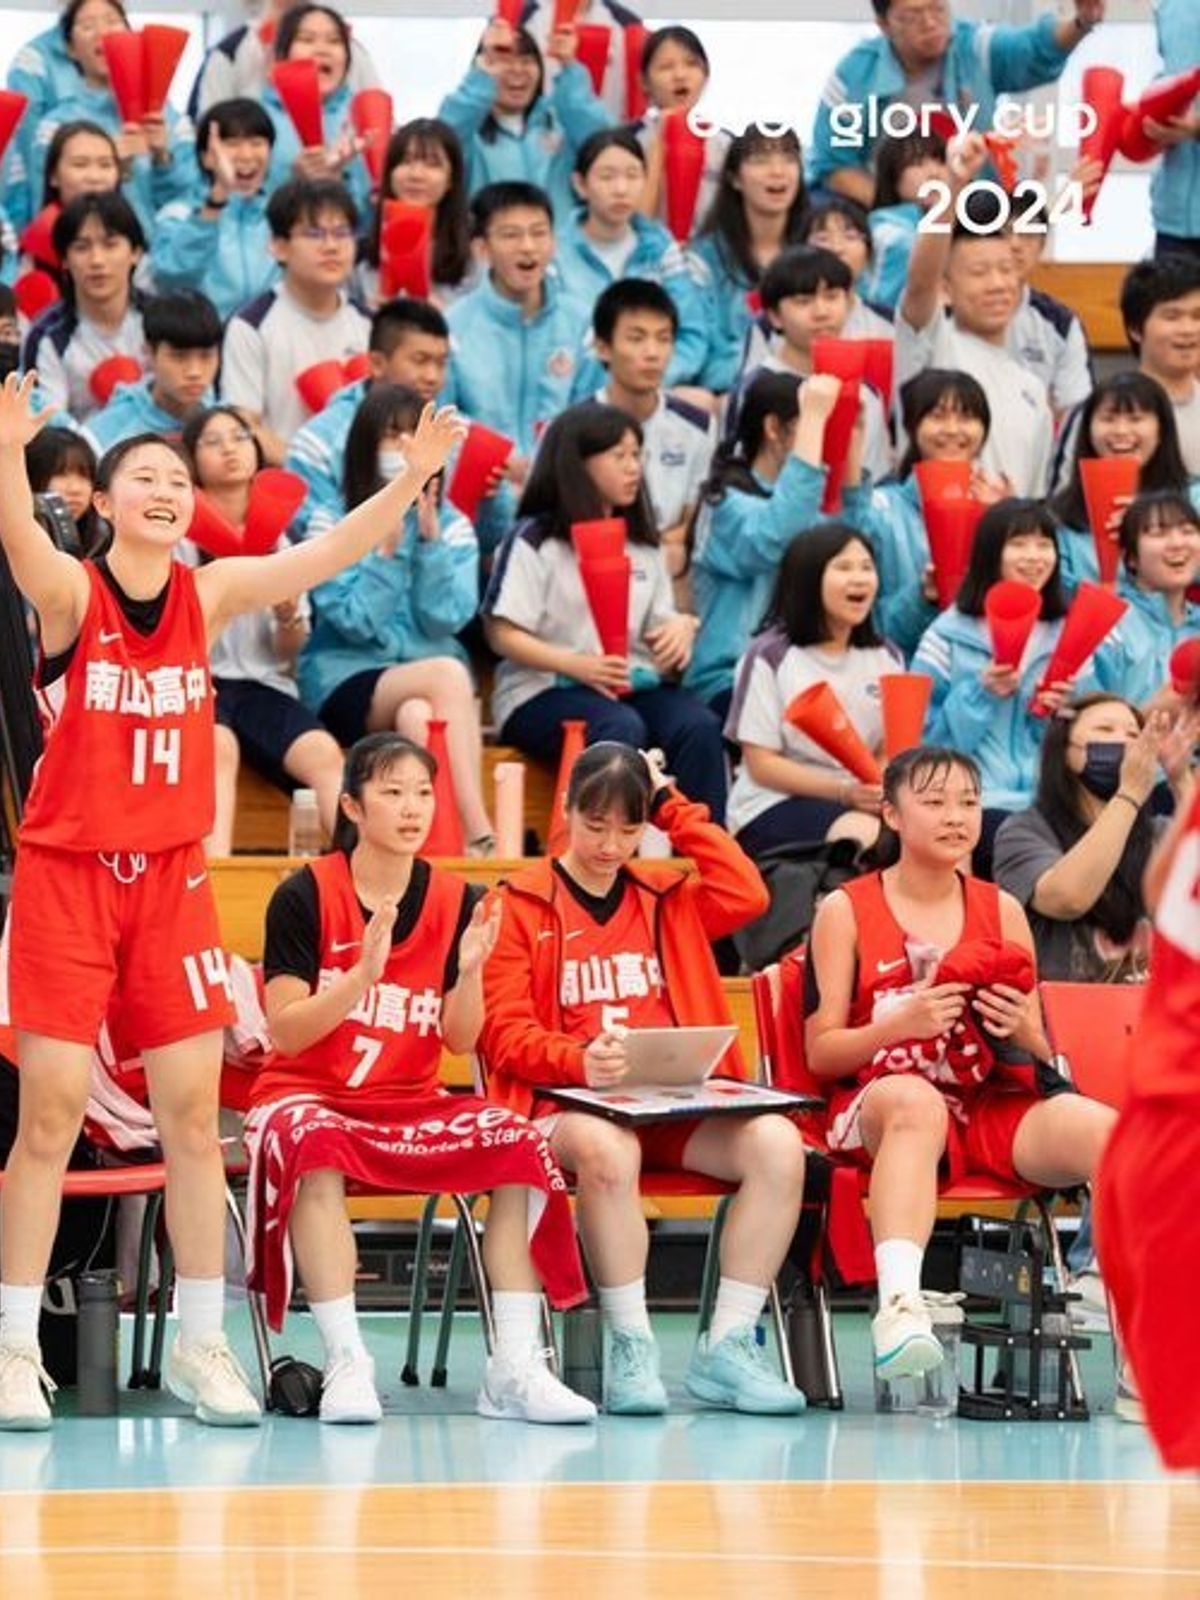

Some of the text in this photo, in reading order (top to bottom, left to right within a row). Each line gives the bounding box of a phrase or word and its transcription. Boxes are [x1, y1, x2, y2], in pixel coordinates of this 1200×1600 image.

[85, 660, 207, 718] 南山高中
[131, 727, 181, 786] 14
[182, 945, 236, 1013] 14
[345, 1034, 384, 1089] 7
